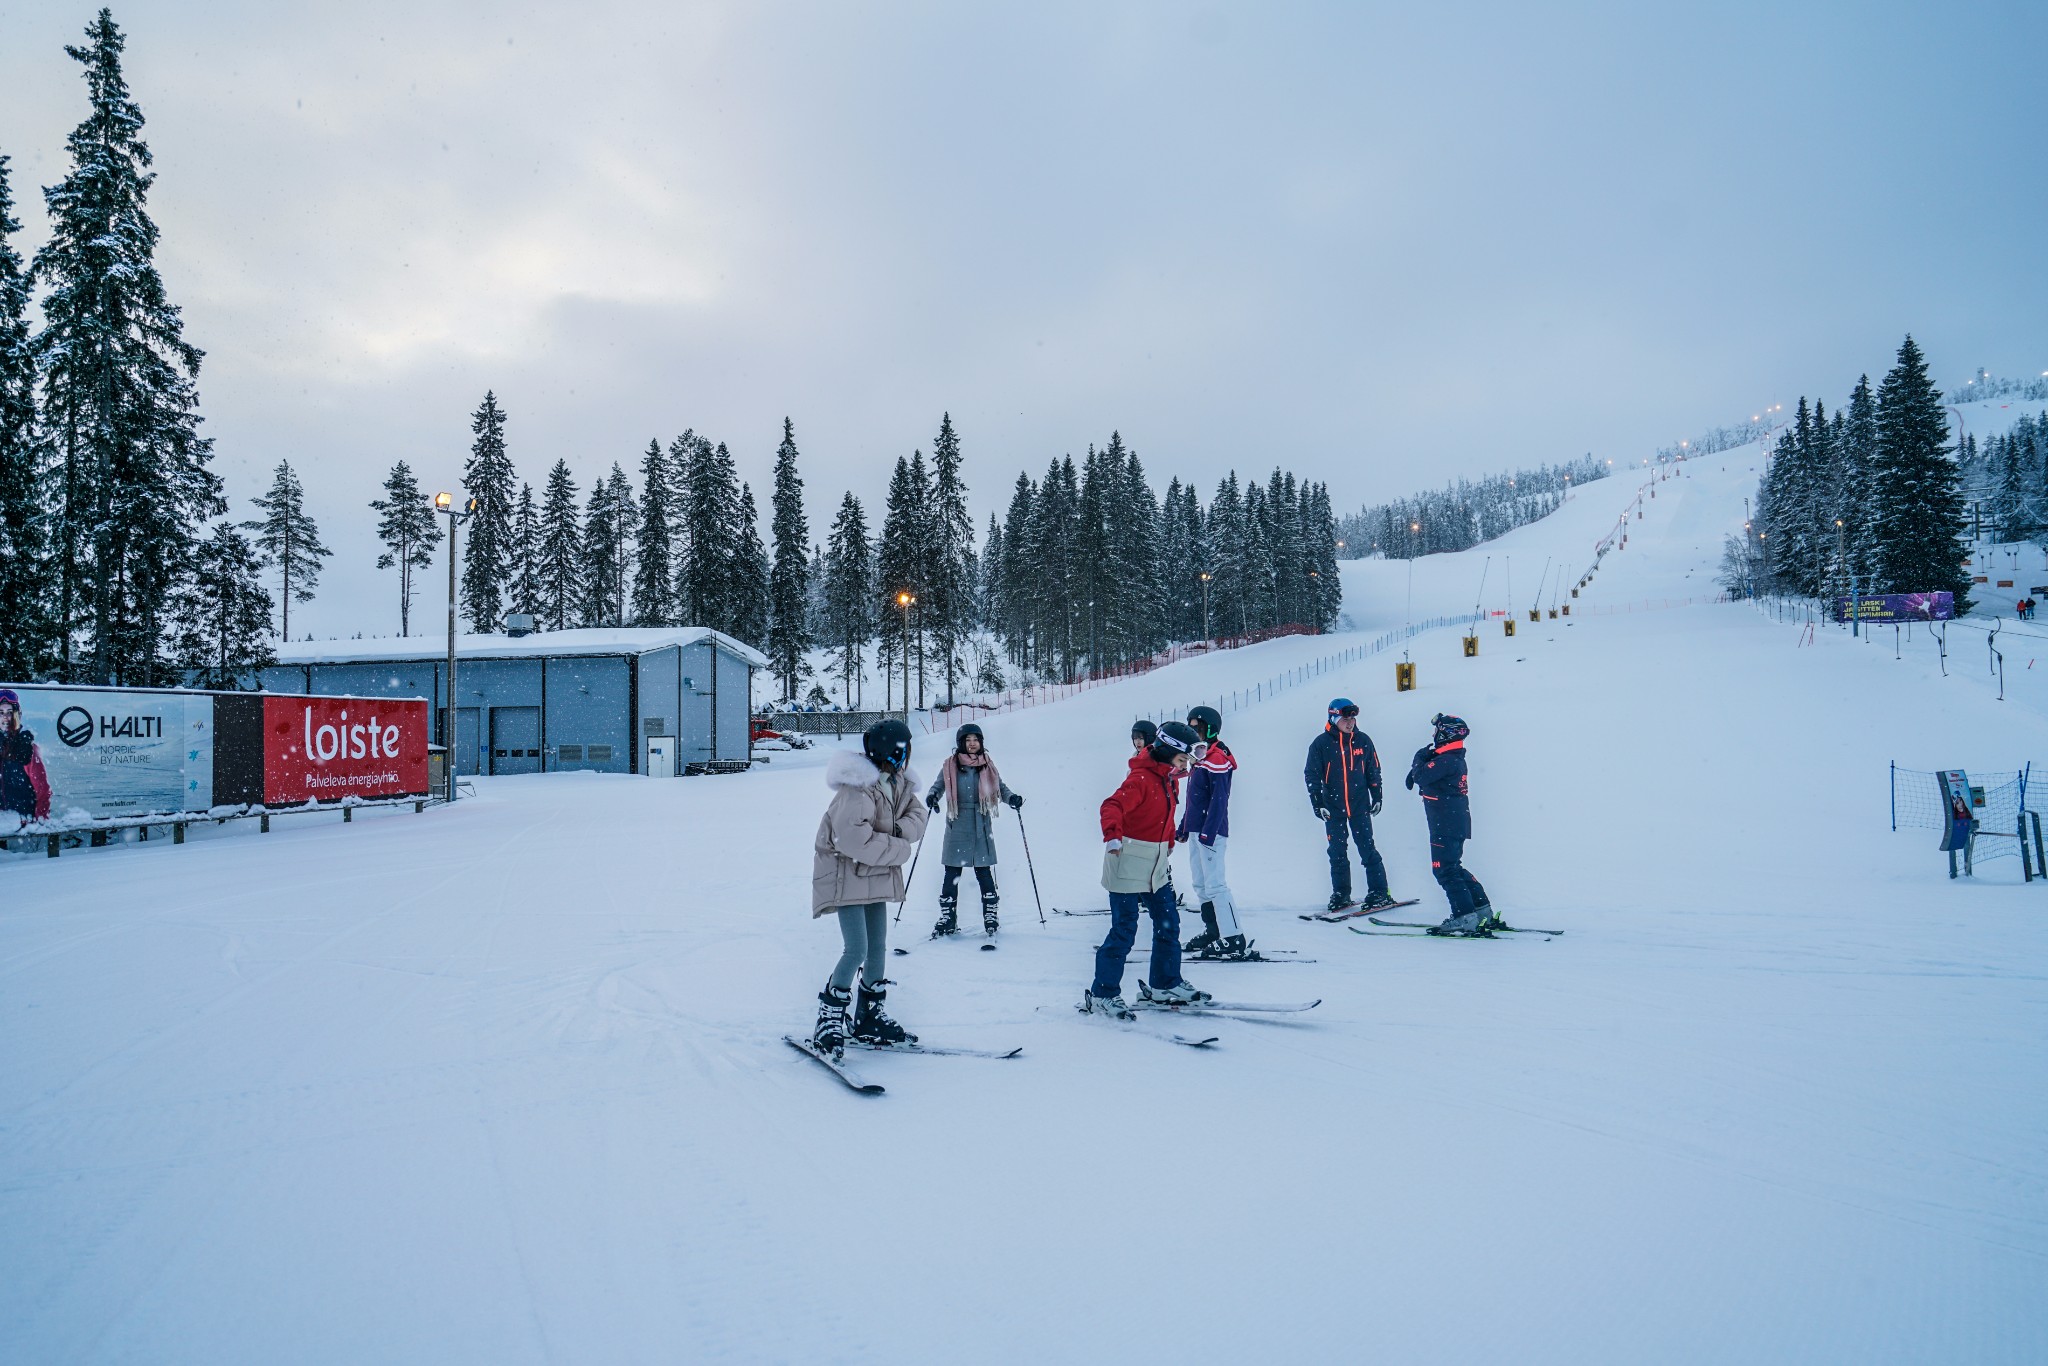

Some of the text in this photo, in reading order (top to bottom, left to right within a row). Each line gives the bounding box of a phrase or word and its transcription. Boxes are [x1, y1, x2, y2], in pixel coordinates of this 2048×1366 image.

[100, 715, 162, 738] HALTI
[304, 705, 399, 761] loiste
[100, 745, 136, 755] NORDIC
[100, 754, 151, 764] BY NATURE
[305, 773, 347, 788] Palveleva
